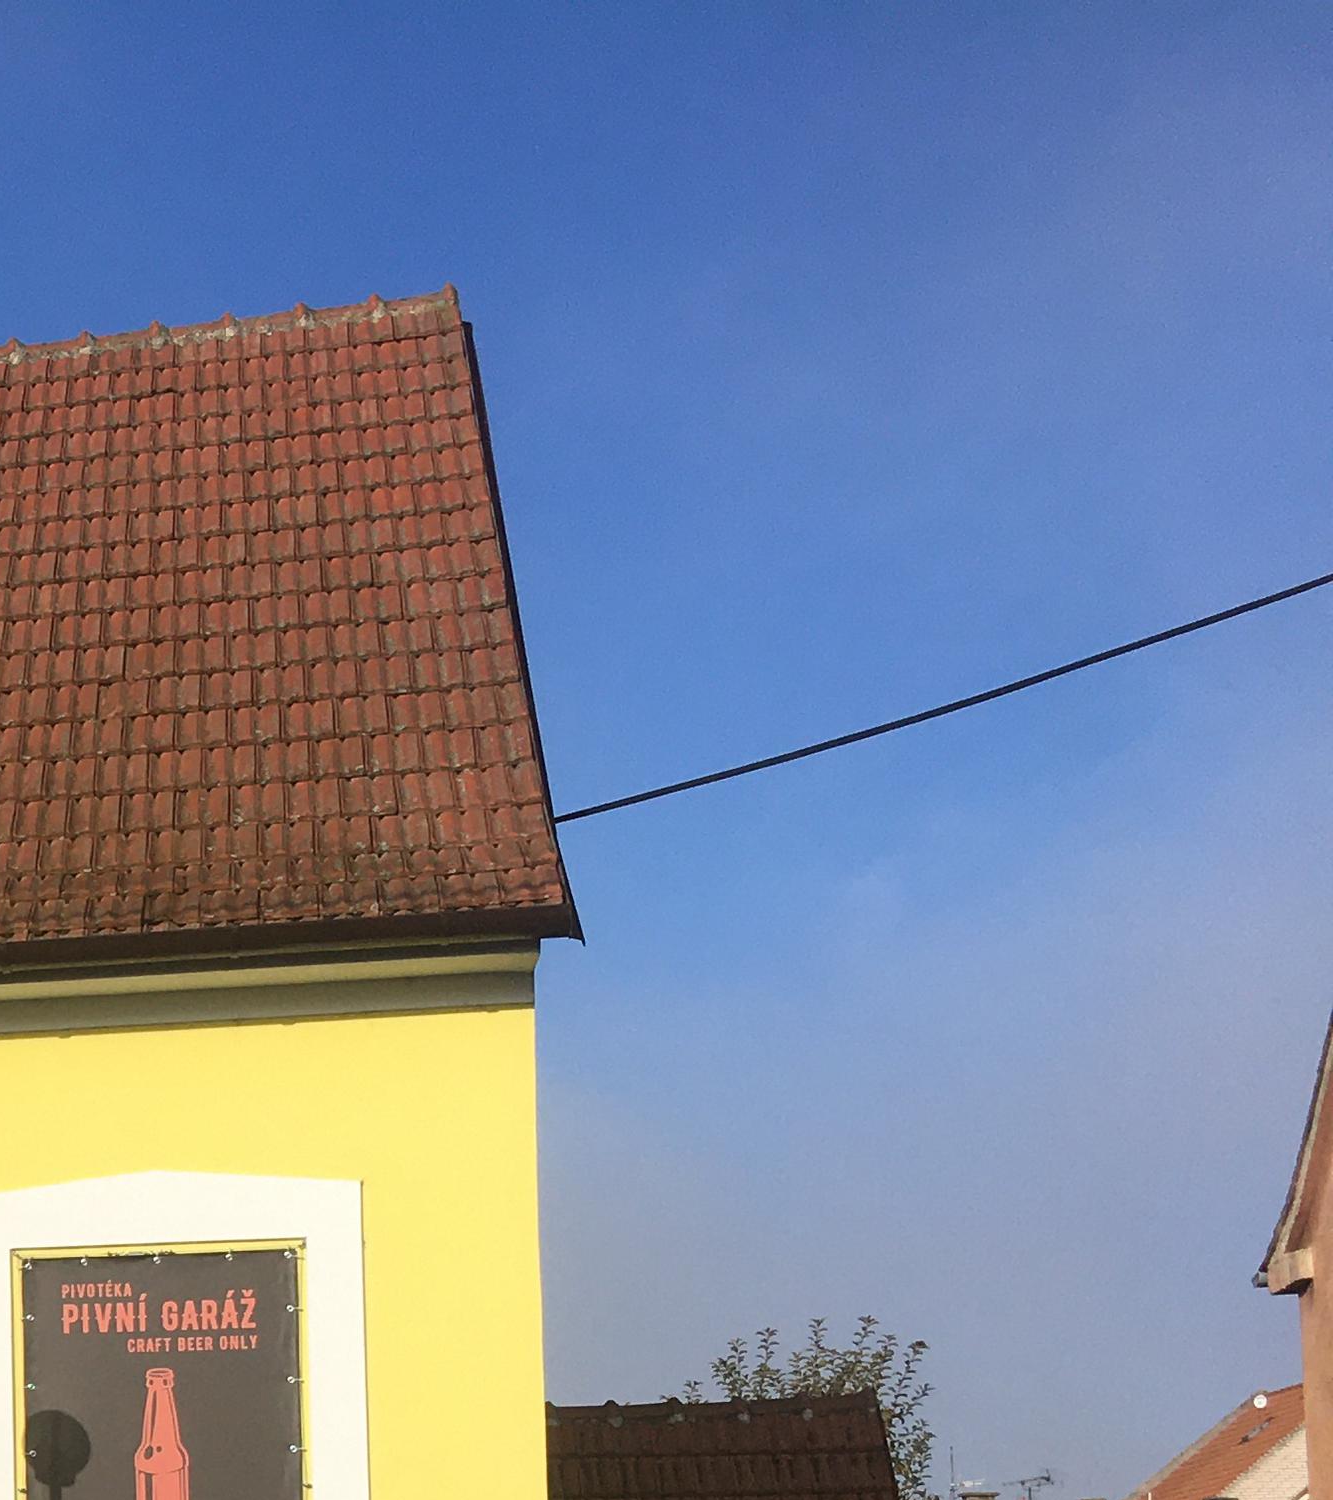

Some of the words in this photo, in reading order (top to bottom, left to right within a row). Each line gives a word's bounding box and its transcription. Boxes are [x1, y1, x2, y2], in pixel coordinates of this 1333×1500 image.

[61, 1280, 132, 1298] PIVOTÉKA
[61, 1293, 148, 1334] PIVNÍ
[161, 1289, 257, 1331] GARÁŽ
[127, 1338, 172, 1353] CRAFT
[177, 1336, 213, 1351] BEER
[219, 1335, 258, 1350] ONLY
